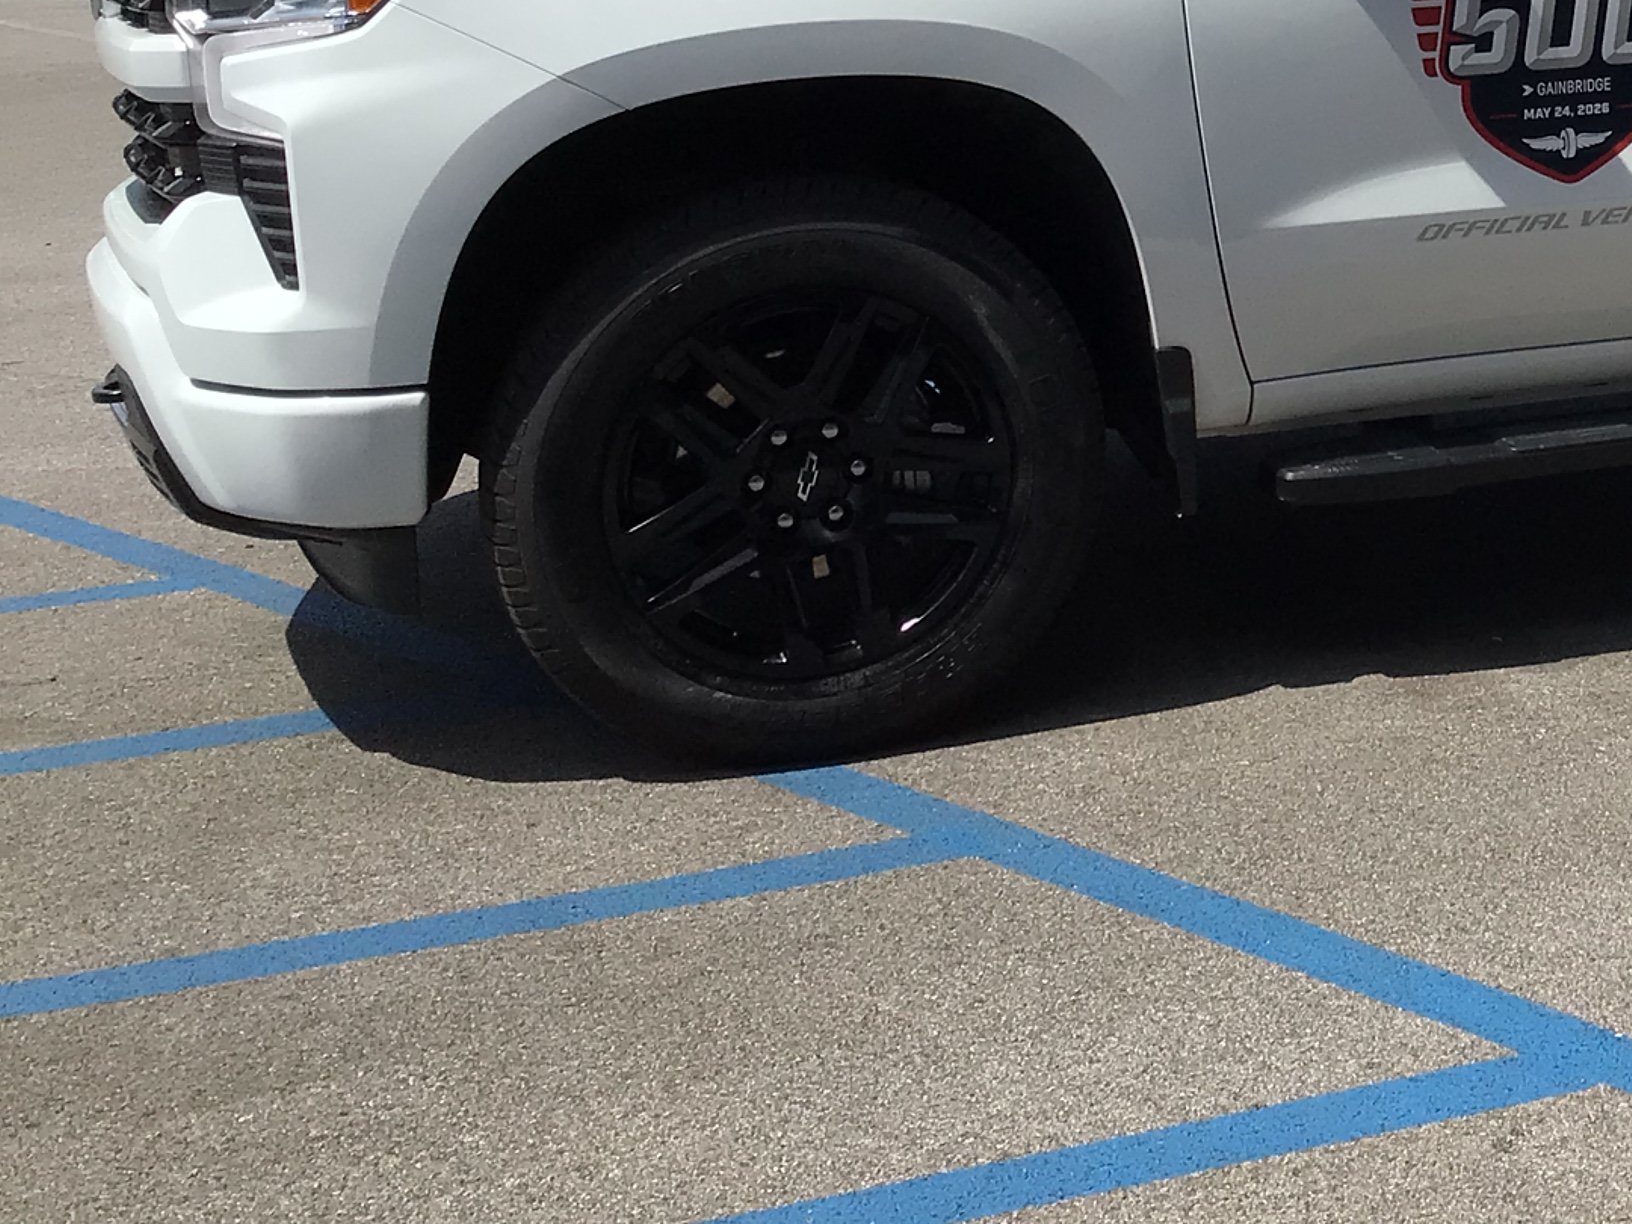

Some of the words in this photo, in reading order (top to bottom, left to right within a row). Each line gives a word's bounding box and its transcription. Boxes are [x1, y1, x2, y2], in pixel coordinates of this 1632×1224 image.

[1537, 77, 1612, 96] GAINBRIDGE
[1523, 107, 1551, 120] MAY
[1554, 105, 1574, 117] 24,
[1577, 102, 1610, 116] 2026
[1416, 212, 1569, 242] OFFICIAL
